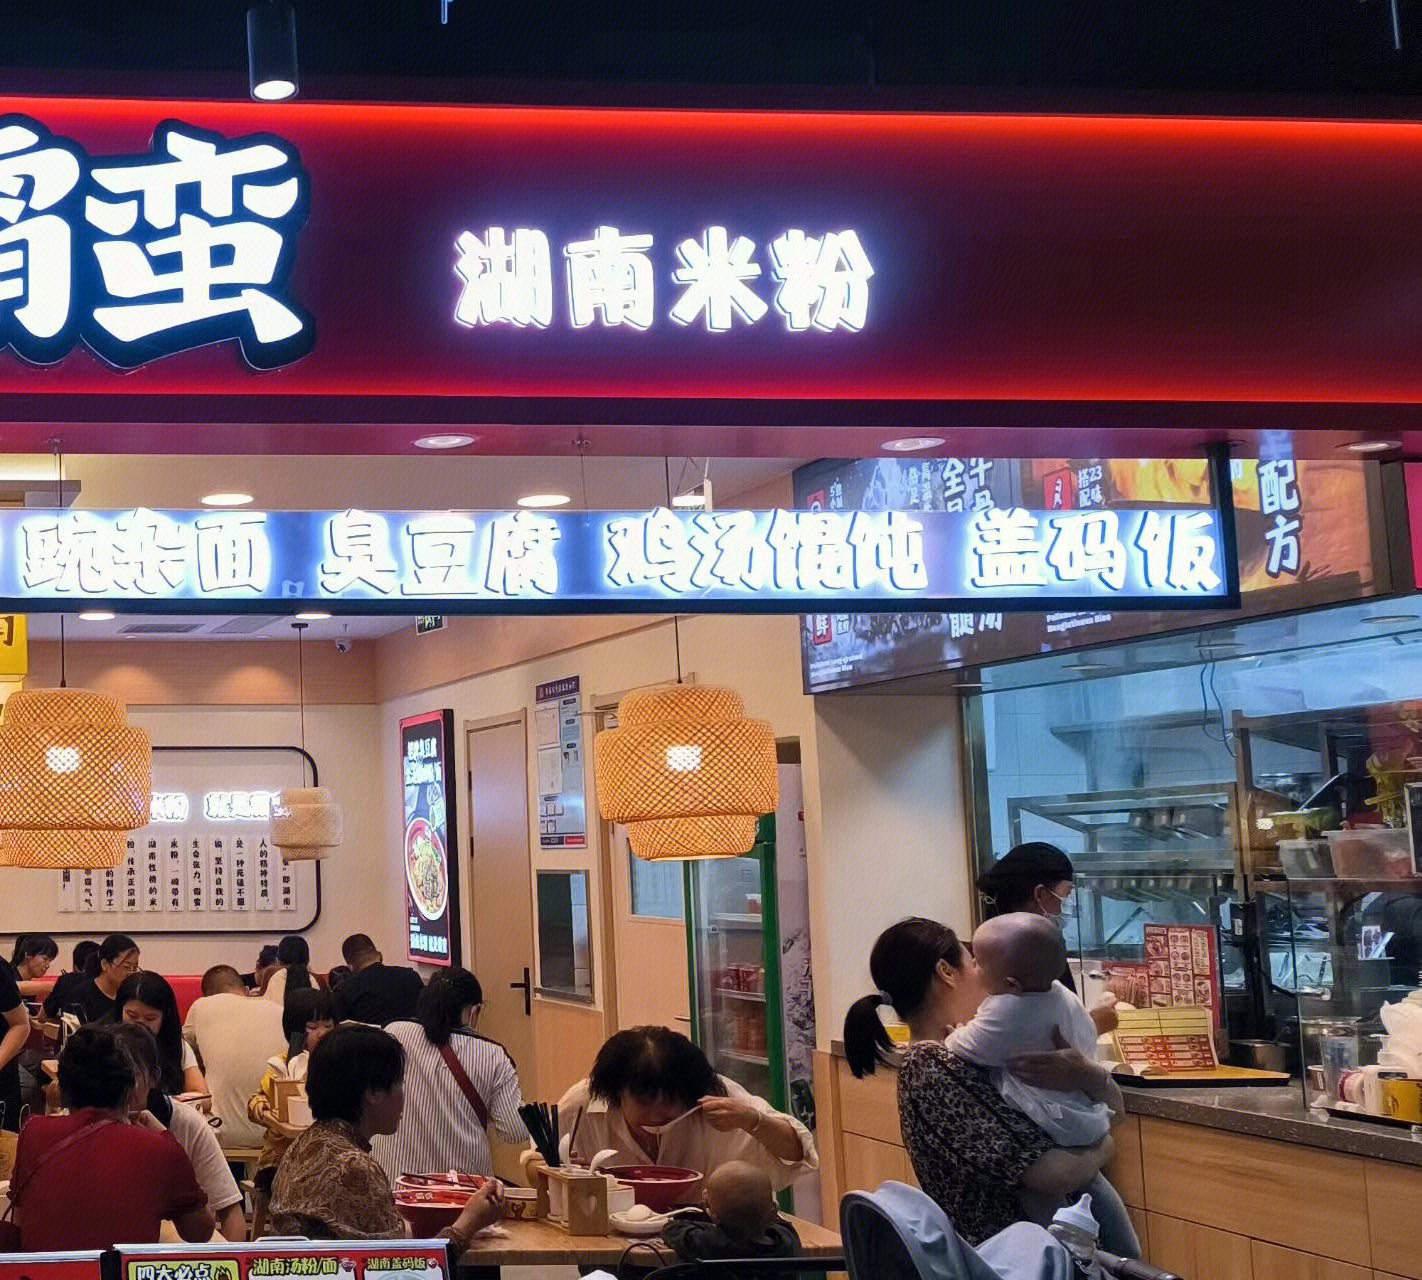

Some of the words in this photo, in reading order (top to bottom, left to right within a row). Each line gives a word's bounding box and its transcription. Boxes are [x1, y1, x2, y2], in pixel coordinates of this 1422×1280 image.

[452, 224, 875, 334] 湖南米粉
[21, 507, 269, 595] 豌杂面
[320, 508, 560, 596] 臭豆腐
[606, 507, 929, 592] 鸡汤馄饨
[971, 507, 1223, 592] 盖码饭
[1258, 459, 1300, 574] 配方
[367, 1257, 427, 1270] 湖南盖码饭
